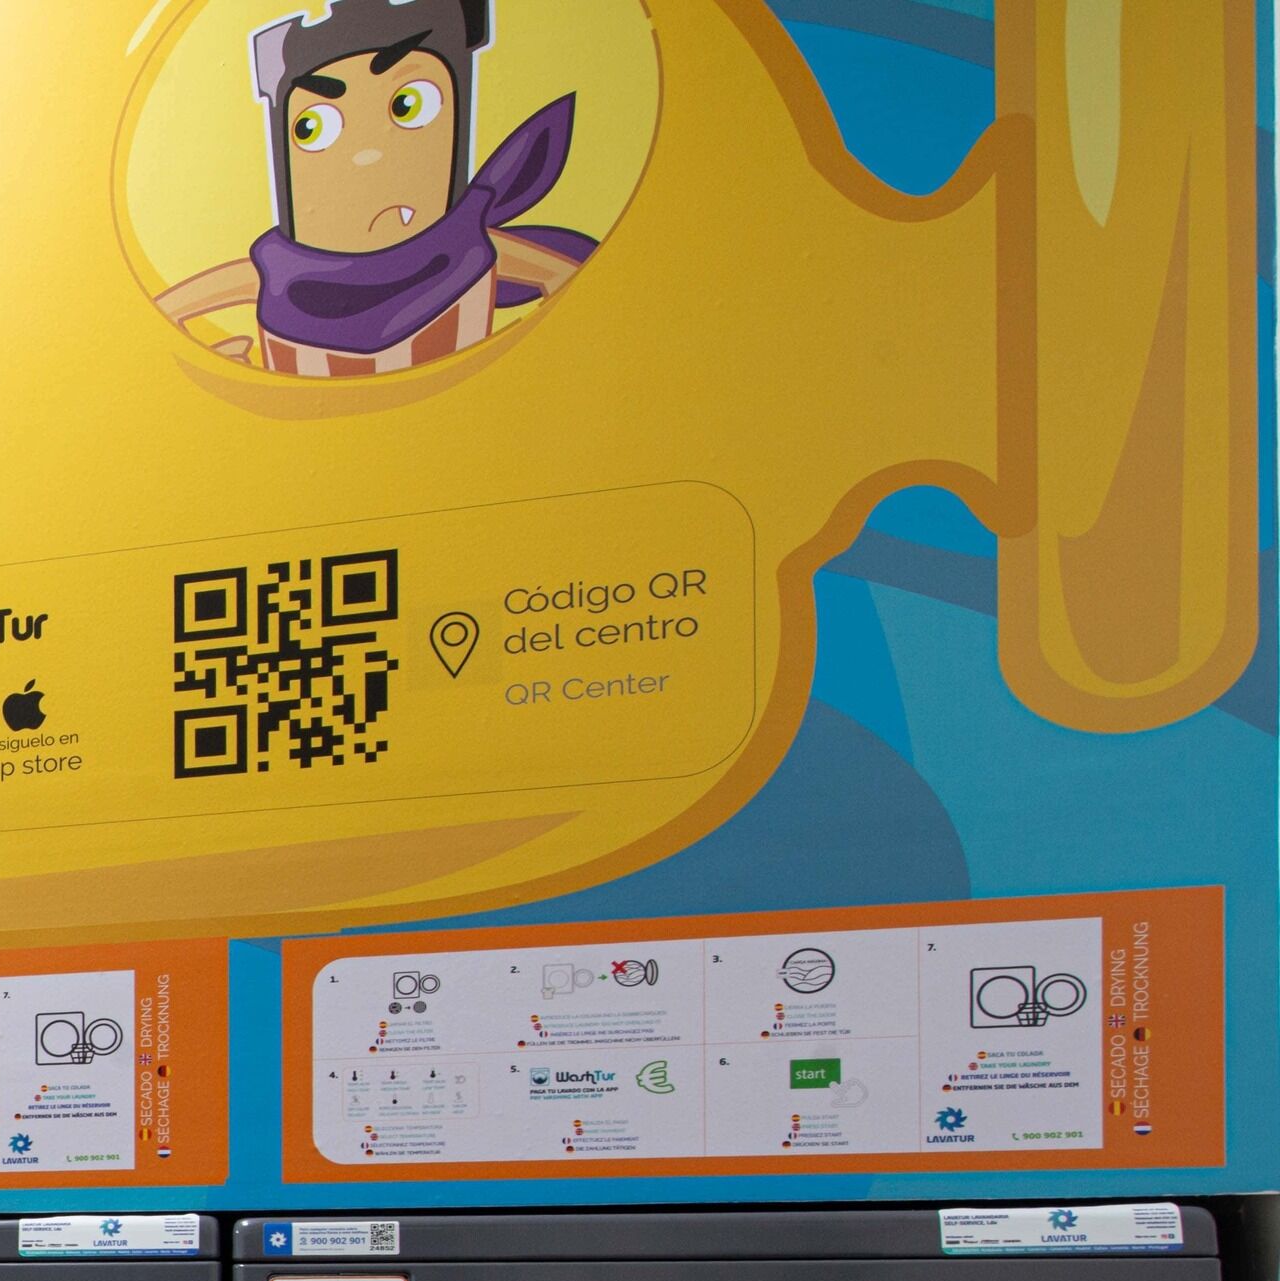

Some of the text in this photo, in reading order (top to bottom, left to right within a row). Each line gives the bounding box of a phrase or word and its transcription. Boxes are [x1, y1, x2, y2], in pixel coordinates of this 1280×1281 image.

[504, 568, 707, 615] Código QR
[504, 614, 699, 654] del centro
[504, 673, 670, 706] QR Center
[60, 733, 79, 745] en
[22, 753, 83, 775] store
[1133, 922, 1150, 1022] TROCKNUNG
[158, 974, 169, 1061] TROCKNUNG
[1110, 949, 1126, 1098] SECADO DRYING
[141, 997, 152, 1126] SECADO DRYING
[796, 1068, 826, 1080] start
[556, 1070, 616, 1084] WashTur
[926, 1135, 975, 1143] LAVATUR
[2, 1157, 39, 1165] LAVATUR
[1041, 1235, 1087, 1243] LAVATUR
